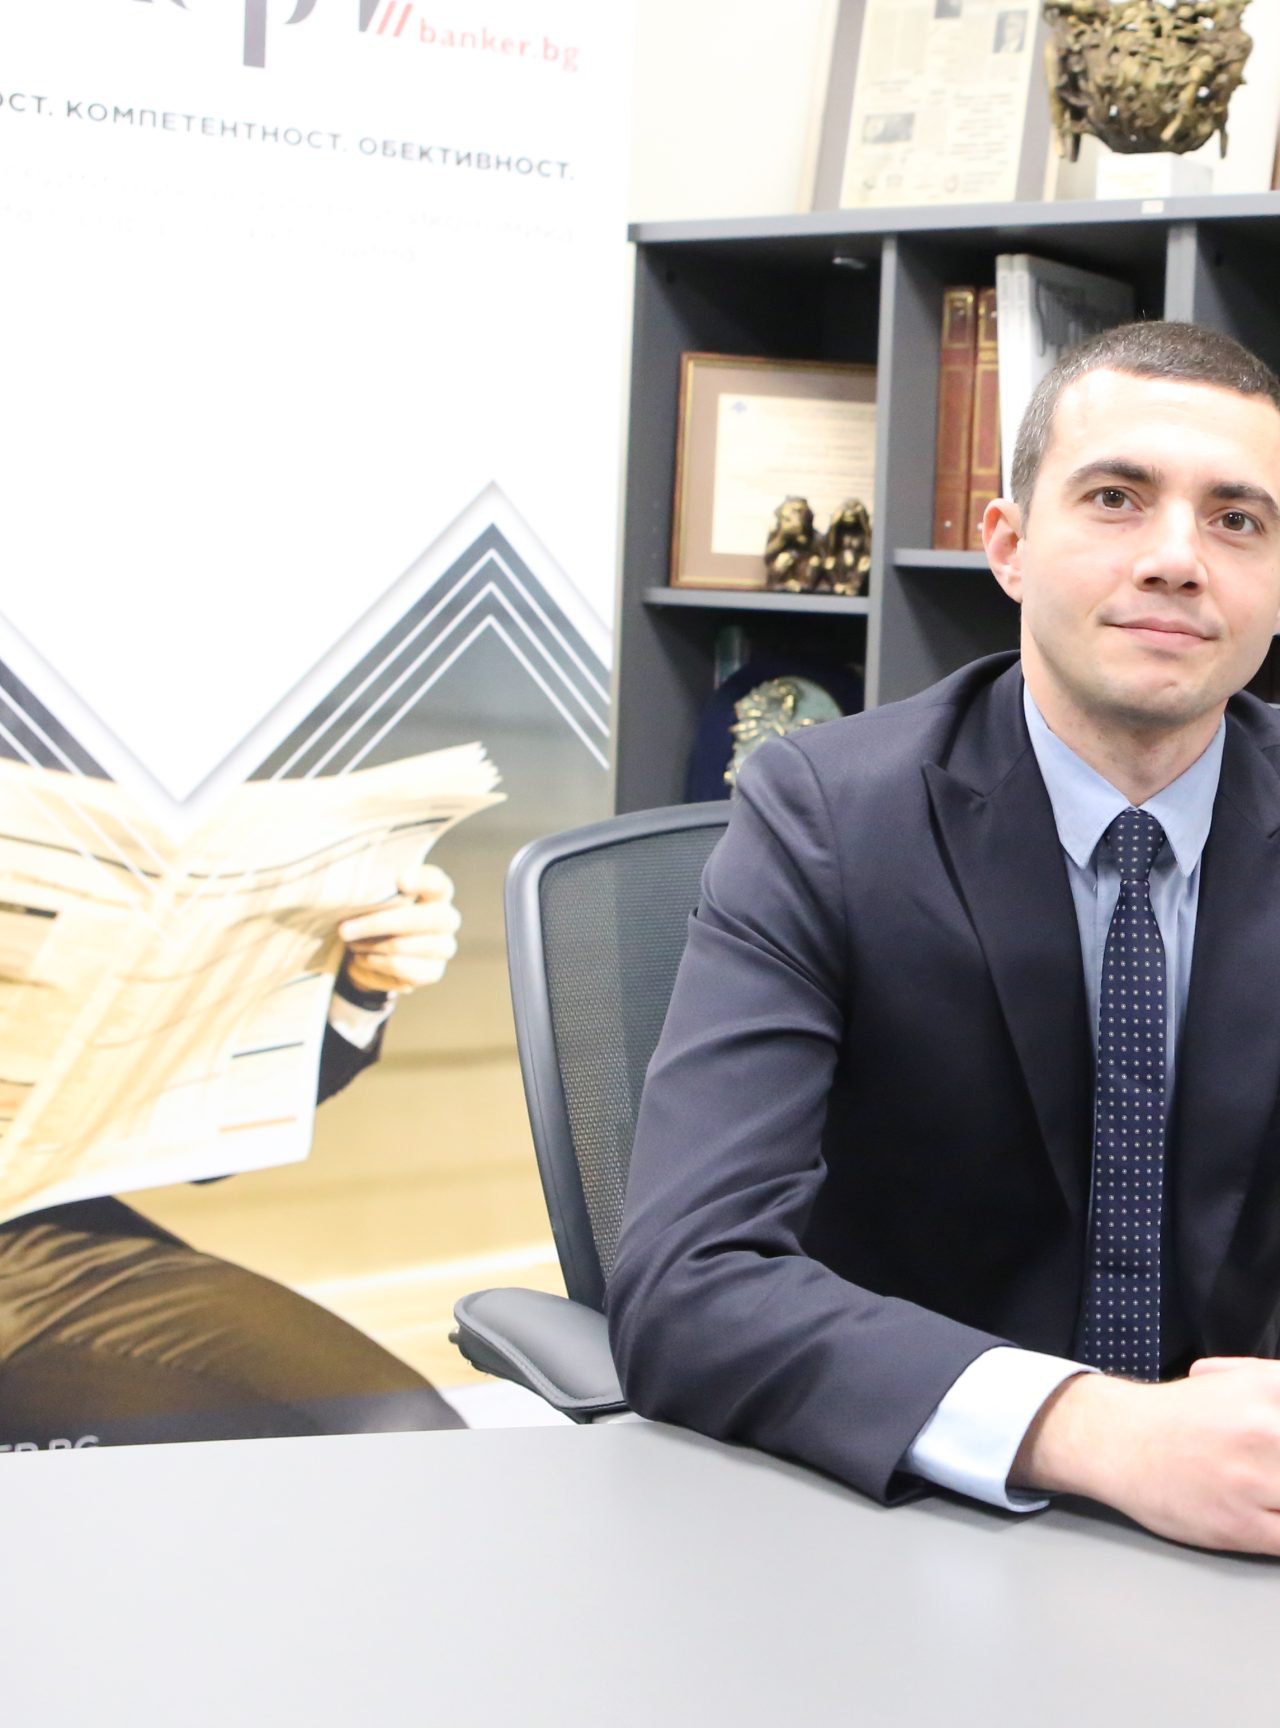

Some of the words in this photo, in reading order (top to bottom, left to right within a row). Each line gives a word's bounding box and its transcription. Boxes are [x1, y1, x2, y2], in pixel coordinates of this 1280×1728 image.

[419, 17, 580, 73] banker.bg
[0, 92, 53, 117] СТ.
[66, 99, 347, 153] КОМПЕТЕНТНОСТ.
[359, 137, 575, 181] ОБЕКТИВНОСТ.
